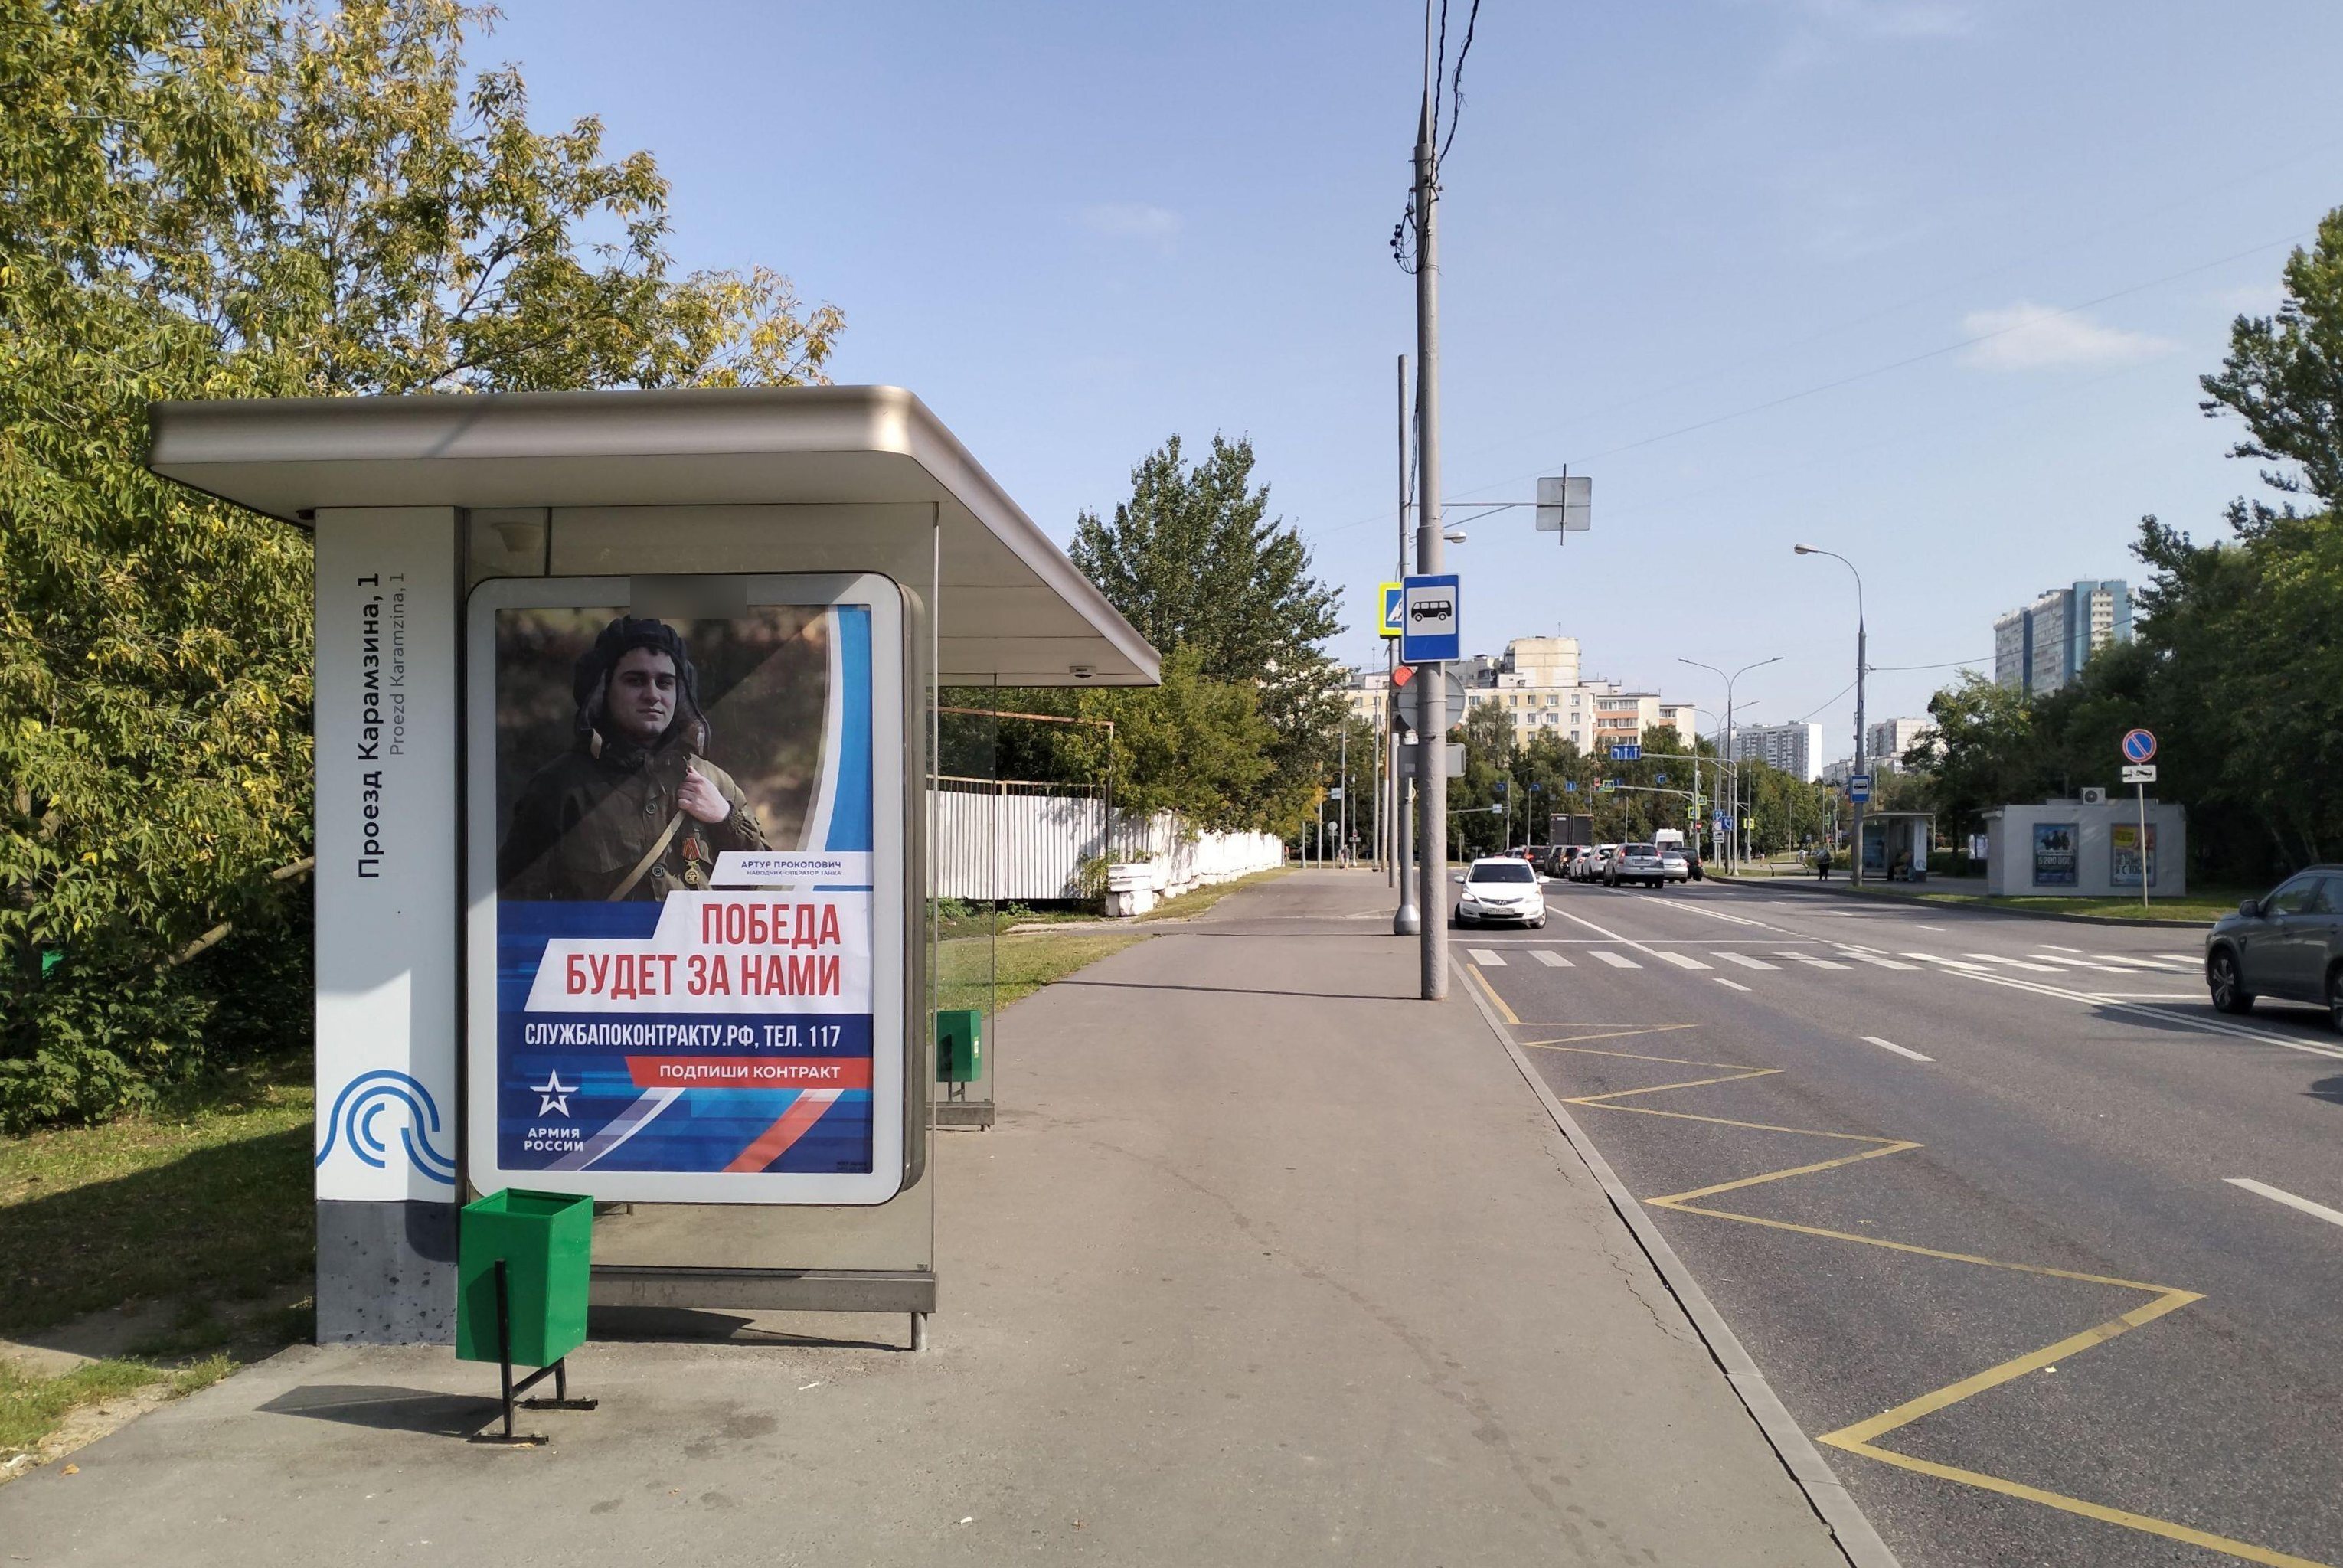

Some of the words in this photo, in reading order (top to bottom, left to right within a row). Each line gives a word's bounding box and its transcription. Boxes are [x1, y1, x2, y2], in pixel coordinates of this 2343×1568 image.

[358, 573, 379, 587] 1
[389, 573, 404, 582] 1
[389, 587, 407, 687] Karamzina,
[358, 594, 384, 760] Карамзина,
[389, 693, 405, 756] Proezd
[358, 770, 384, 878] Проезд
[773, 861, 841, 869] ПРОКОПОВИЧ
[701, 903, 841, 950] ПОБЕДА
[566, 954, 677, 1000] БУДЕТ
[688, 955, 730, 996] ЗА
[740, 955, 840, 996] НАМИ
[524, 1024, 759, 1049] СЛУЖБАПОКОНТРАКТУ.РФ,
[763, 1025, 802, 1047] ТЕЛ.
[809, 1025, 841, 1047] 117
[659, 1065, 749, 1080] ПОДПИШИ
[753, 1066, 841, 1079] КОНТРАКТ
[528, 1127, 580, 1138] АРМИЯ
[524, 1139, 583, 1152] РОССИИ
